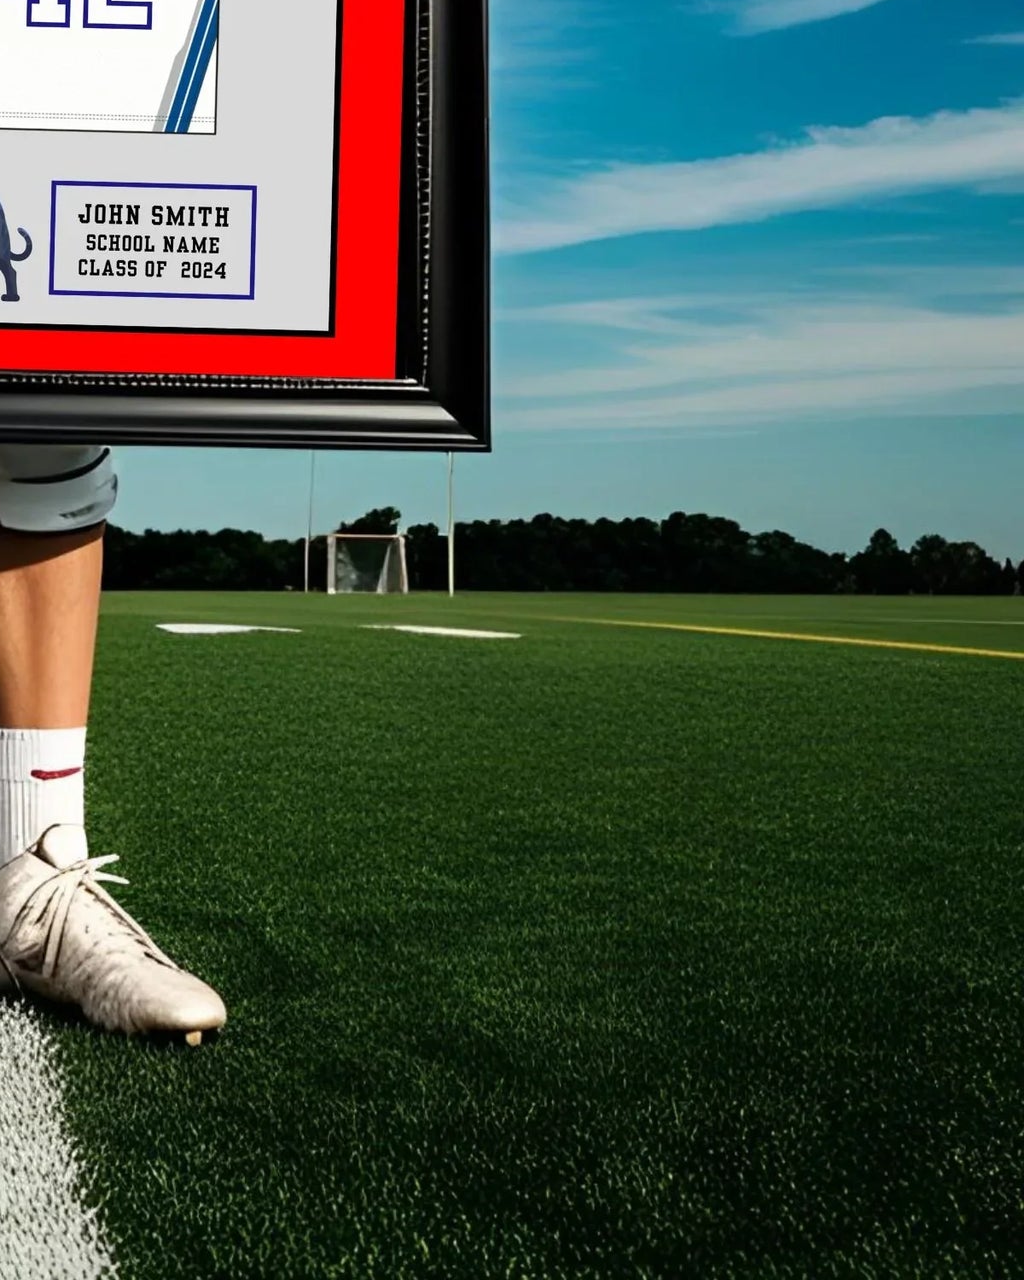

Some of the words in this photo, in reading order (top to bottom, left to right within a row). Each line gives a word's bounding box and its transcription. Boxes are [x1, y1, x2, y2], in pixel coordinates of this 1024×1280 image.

[78, 203, 140, 225] JOHN
[151, 205, 229, 227] SMITH
[86, 234, 155, 252] SCHOOL
[163, 236, 220, 254] NAME
[78, 259, 137, 277] CLASS
[145, 261, 167, 278] OF
[181, 261, 226, 279] 2024
